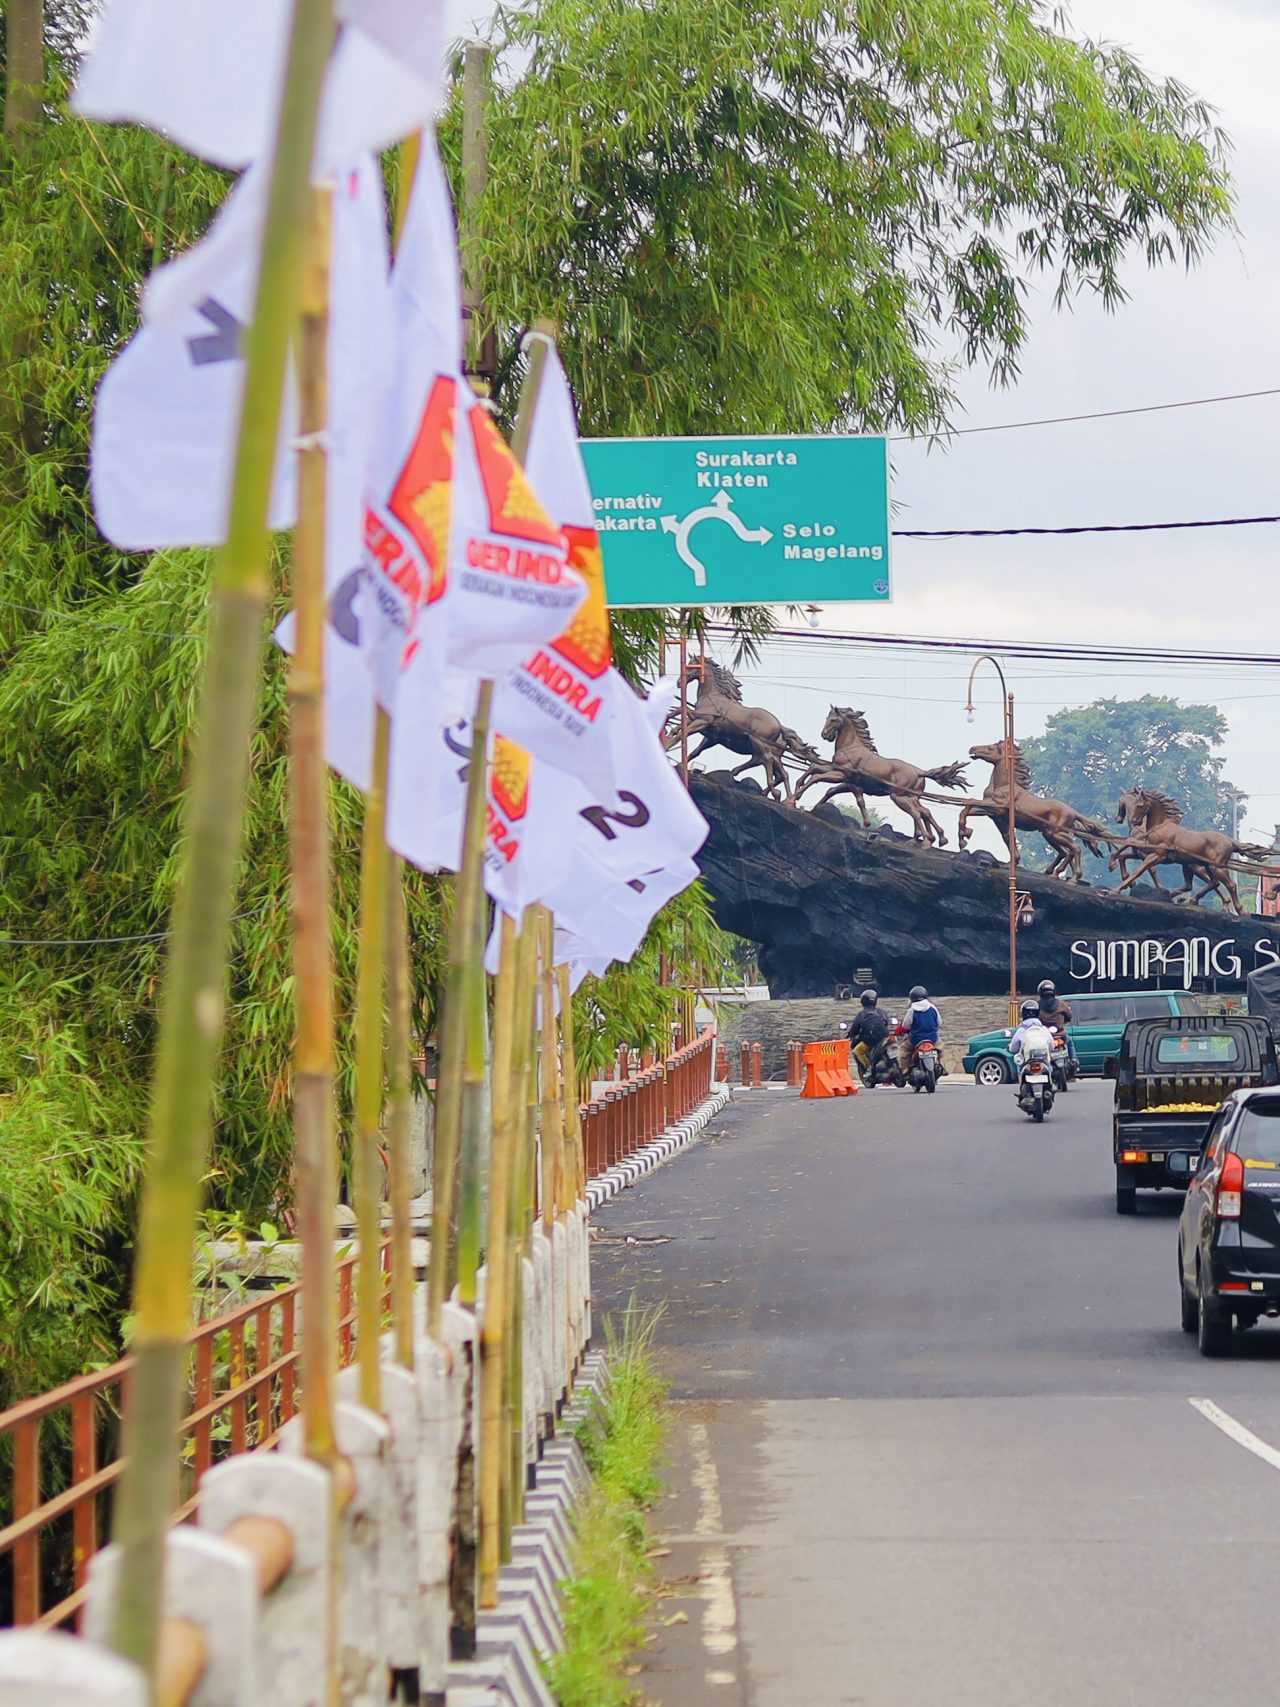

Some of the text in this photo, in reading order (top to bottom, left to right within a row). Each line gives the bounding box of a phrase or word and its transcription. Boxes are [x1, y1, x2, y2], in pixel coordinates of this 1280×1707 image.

[695, 449, 797, 468] Surakarta
[697, 472, 768, 488] Klaten
[592, 493, 662, 510] ernativ
[594, 515, 657, 531] akarta
[783, 523, 836, 539] Selo
[783, 544, 883, 562] Magelang
[519, 648, 604, 724] INDRA
[1069, 937, 1241, 990] SIMPANG
